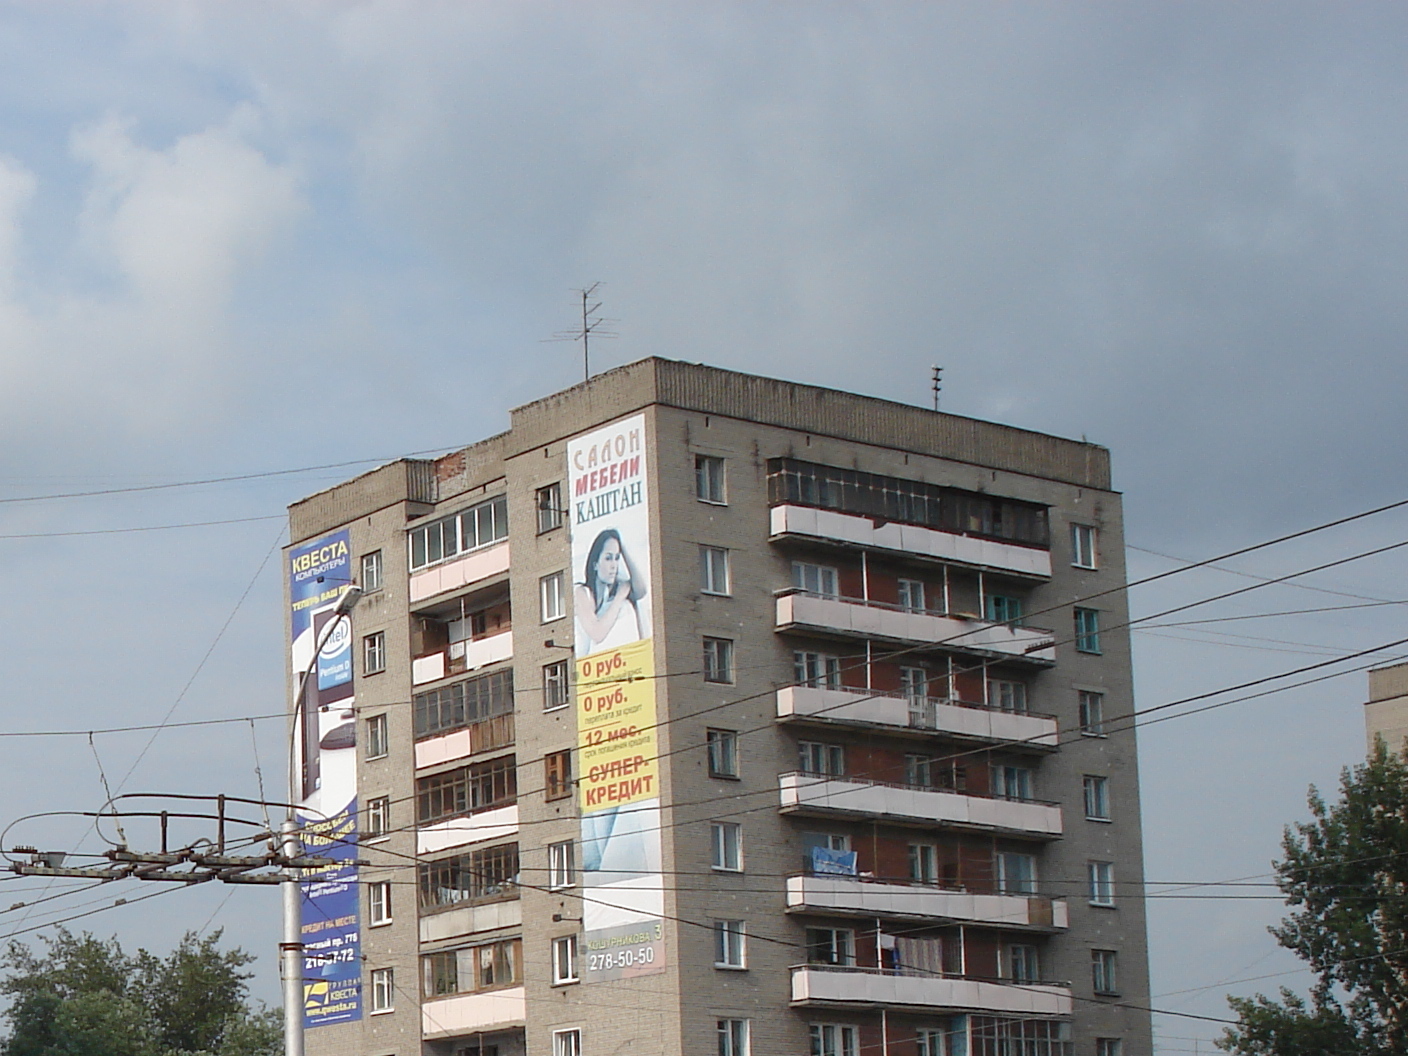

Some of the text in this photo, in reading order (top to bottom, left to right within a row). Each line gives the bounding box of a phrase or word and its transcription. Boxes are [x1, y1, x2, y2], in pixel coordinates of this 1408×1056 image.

[573, 428, 640, 471] САЛОН
[575, 455, 641, 497] МЕБЕЛИ
[576, 481, 642, 524] КАШТАН
[293, 540, 348, 574] КВЕСТА
[295, 557, 346, 582] КОМПЬЮТЕРЫ
[596, 652, 627, 678] руб.
[597, 687, 628, 713] руб.
[585, 730, 603, 747] 12
[586, 775, 653, 806] КРЕДИТ
[590, 947, 654, 971] 278-50-50
